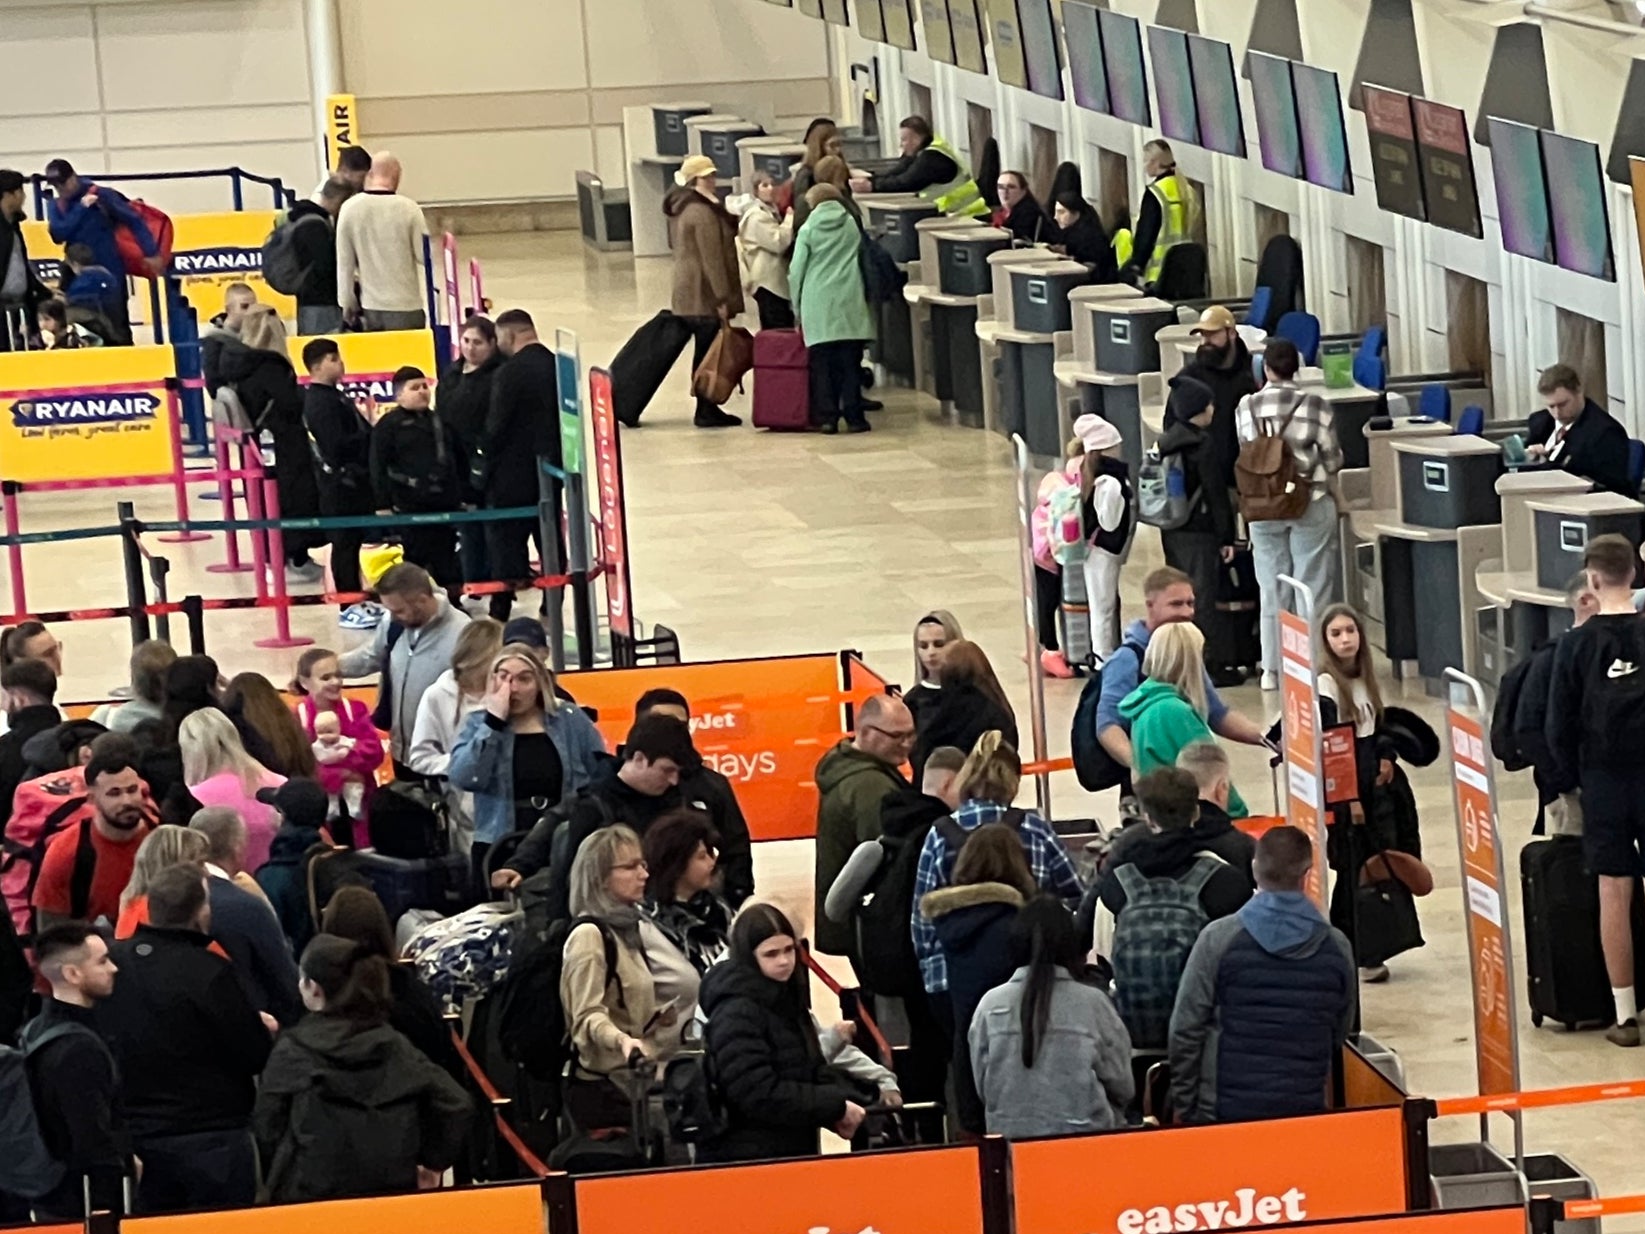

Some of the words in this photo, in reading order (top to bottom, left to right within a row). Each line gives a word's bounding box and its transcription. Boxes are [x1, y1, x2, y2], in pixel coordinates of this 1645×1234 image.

[334, 104, 352, 151] AIR
[35, 397, 153, 420] RYANAIR
[688, 711, 736, 735] yJet
